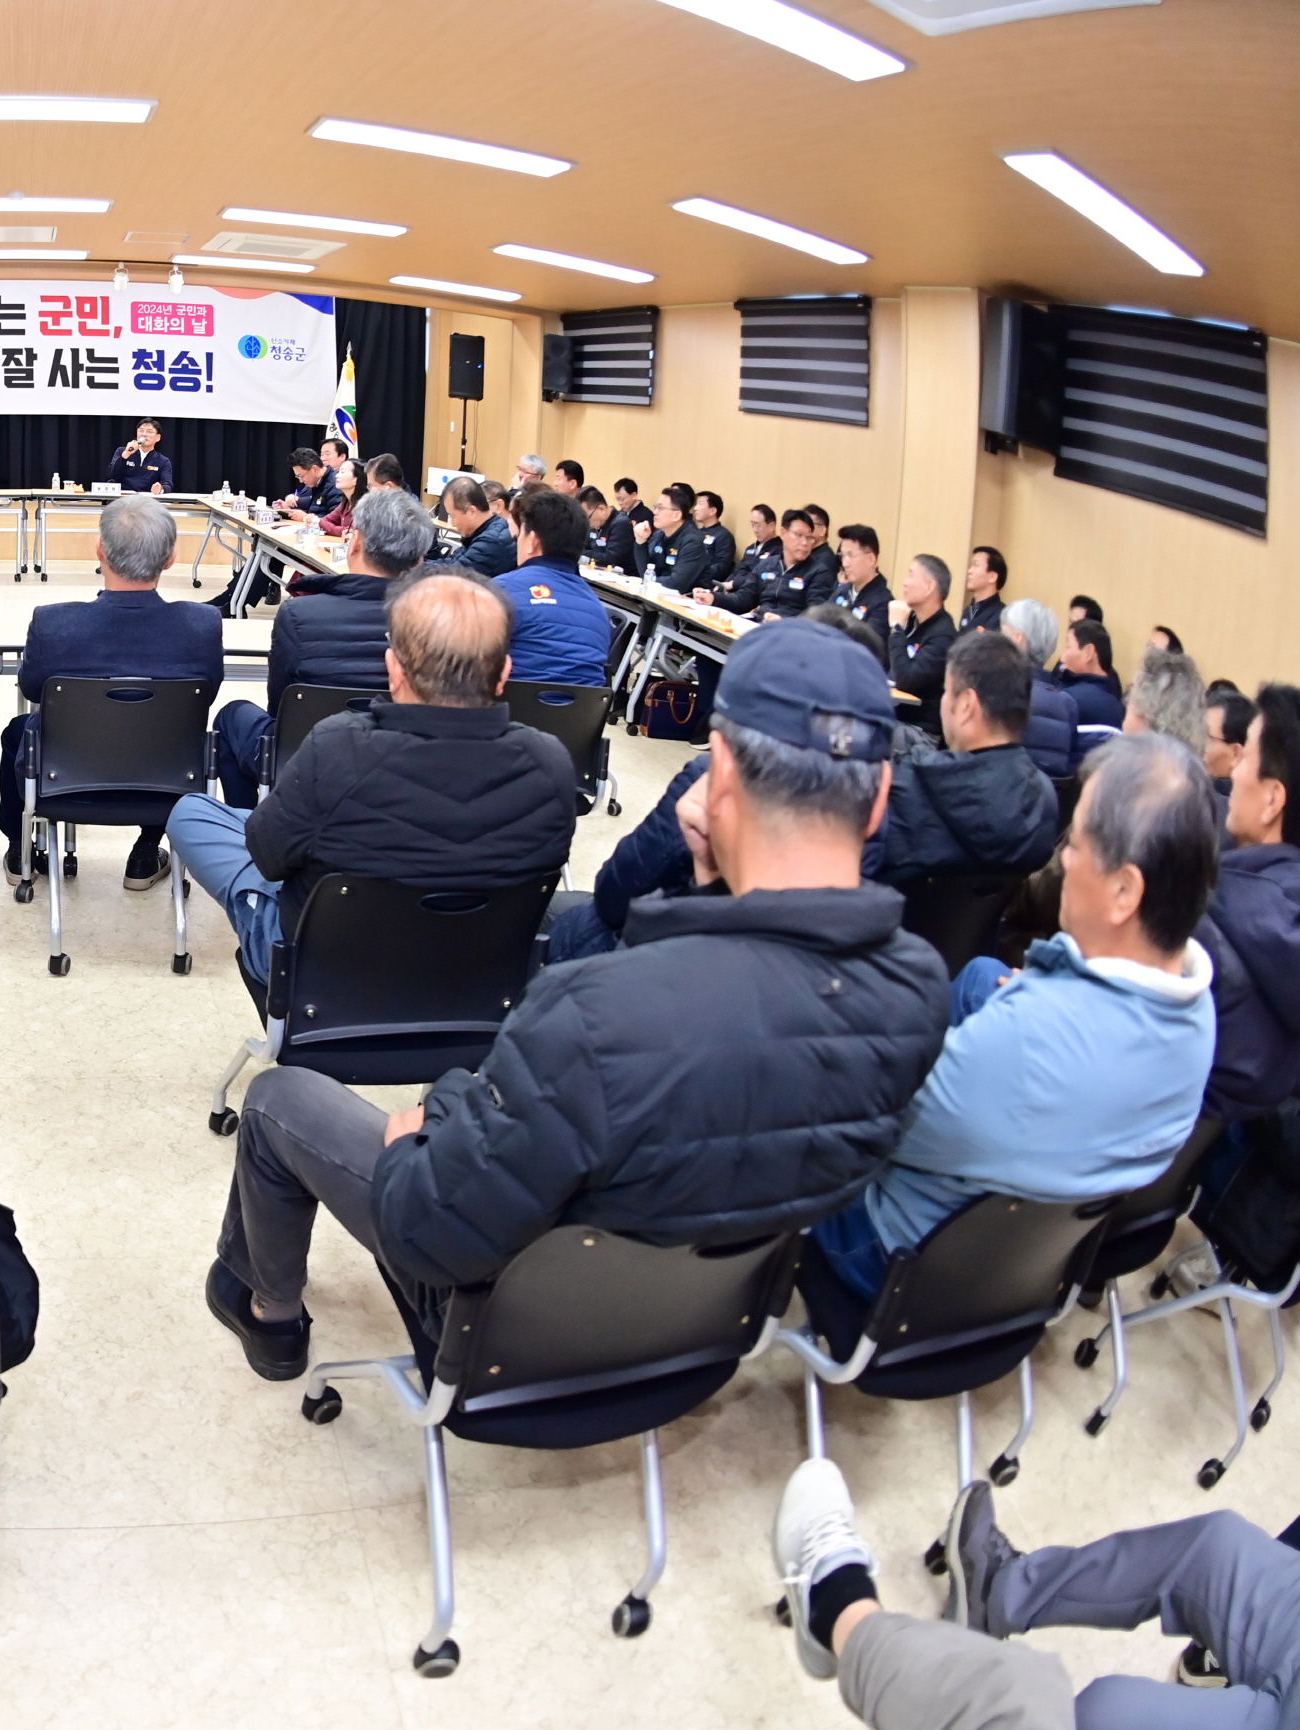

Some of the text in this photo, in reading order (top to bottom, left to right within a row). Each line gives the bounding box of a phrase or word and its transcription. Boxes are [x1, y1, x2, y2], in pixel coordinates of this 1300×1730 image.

[38, 295, 123, 339] 군민,
[137, 303, 208, 318] 2024년 군민과
[137, 315, 208, 335] 대화의 날
[269, 345, 307, 362] 청송군
[1, 347, 38, 389] 잘
[47, 347, 120, 390] 사는
[131, 348, 214, 393] 청송!
